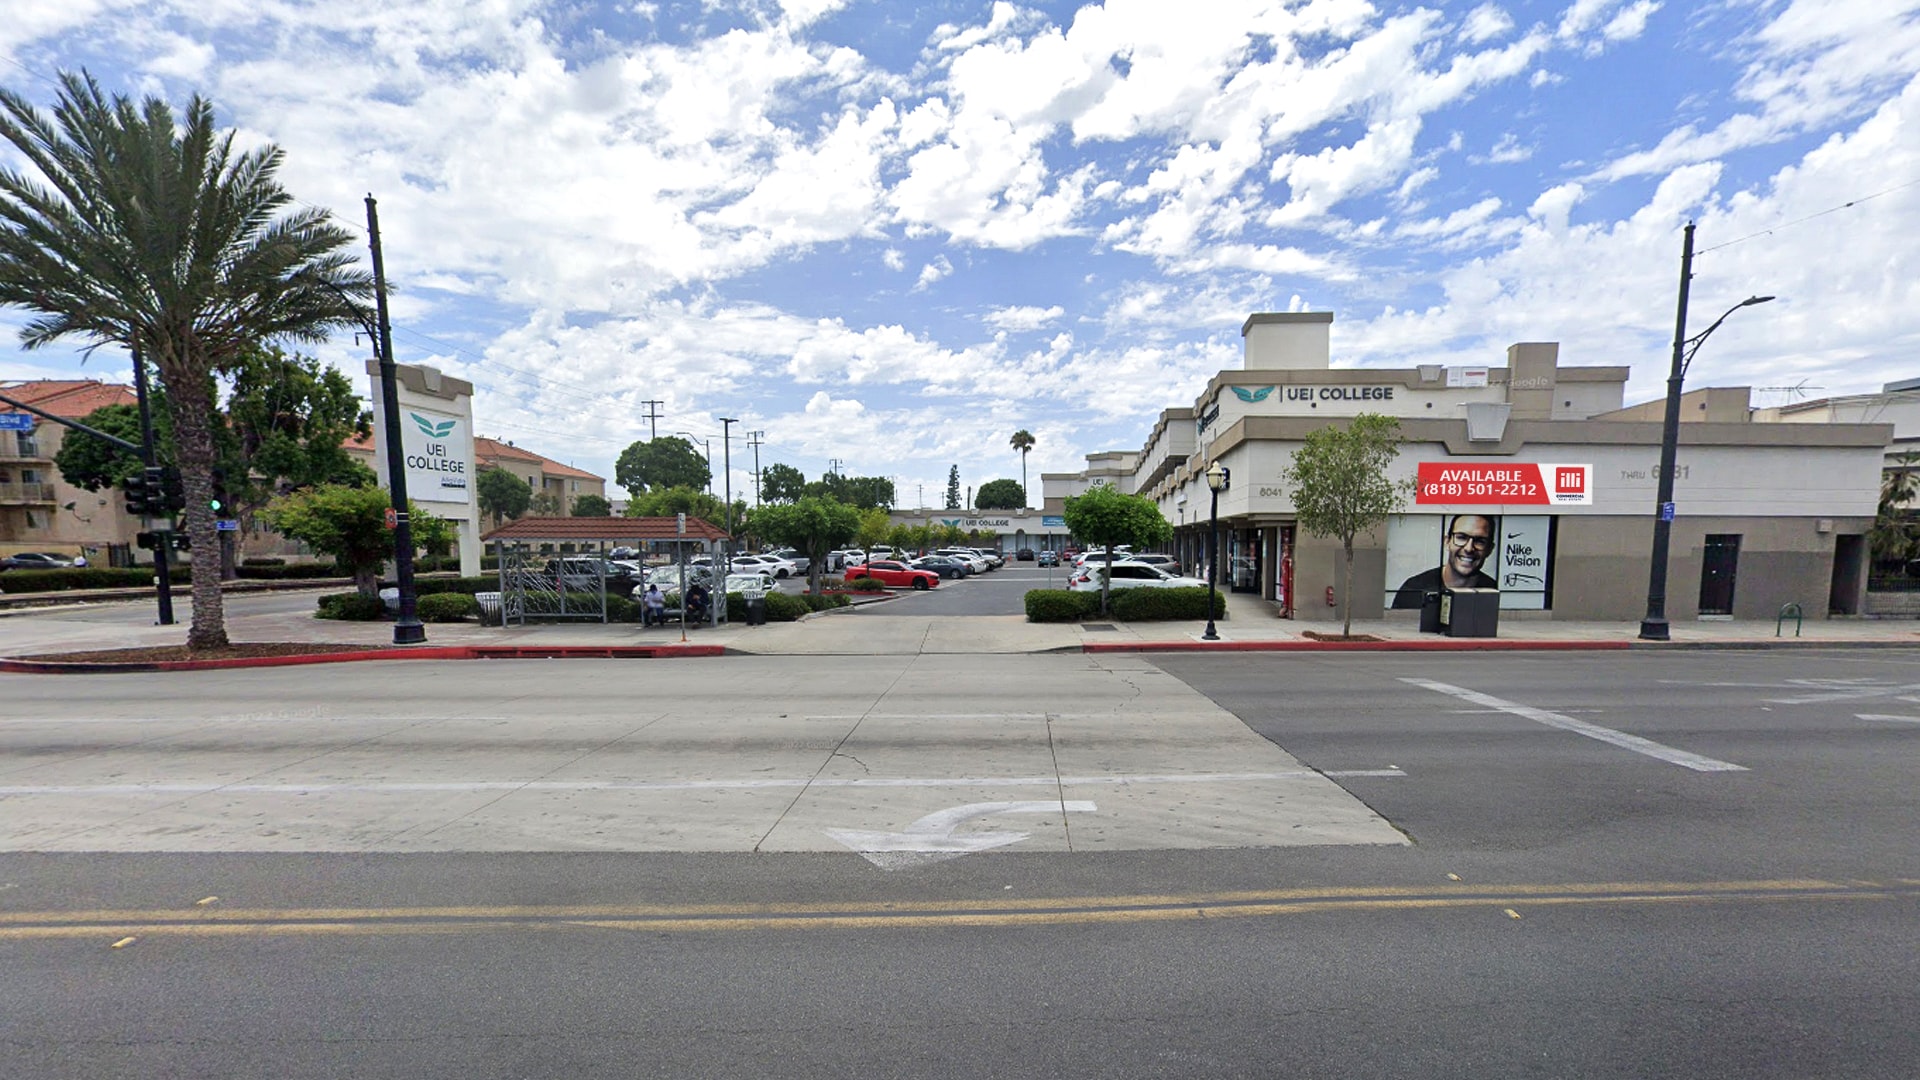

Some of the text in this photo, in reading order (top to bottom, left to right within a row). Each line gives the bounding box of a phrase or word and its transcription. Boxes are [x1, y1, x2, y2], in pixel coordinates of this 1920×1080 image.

[1287, 387, 1394, 400] UEI COLLEGE
[426, 443, 446, 457] UEI
[407, 455, 465, 474] COLLEGE
[1439, 470, 1522, 482] AVAILABLE
[1424, 483, 1537, 497] (818) 501-2212
[1506, 543, 1533, 555] Nike
[1505, 555, 1541, 567] Vision
